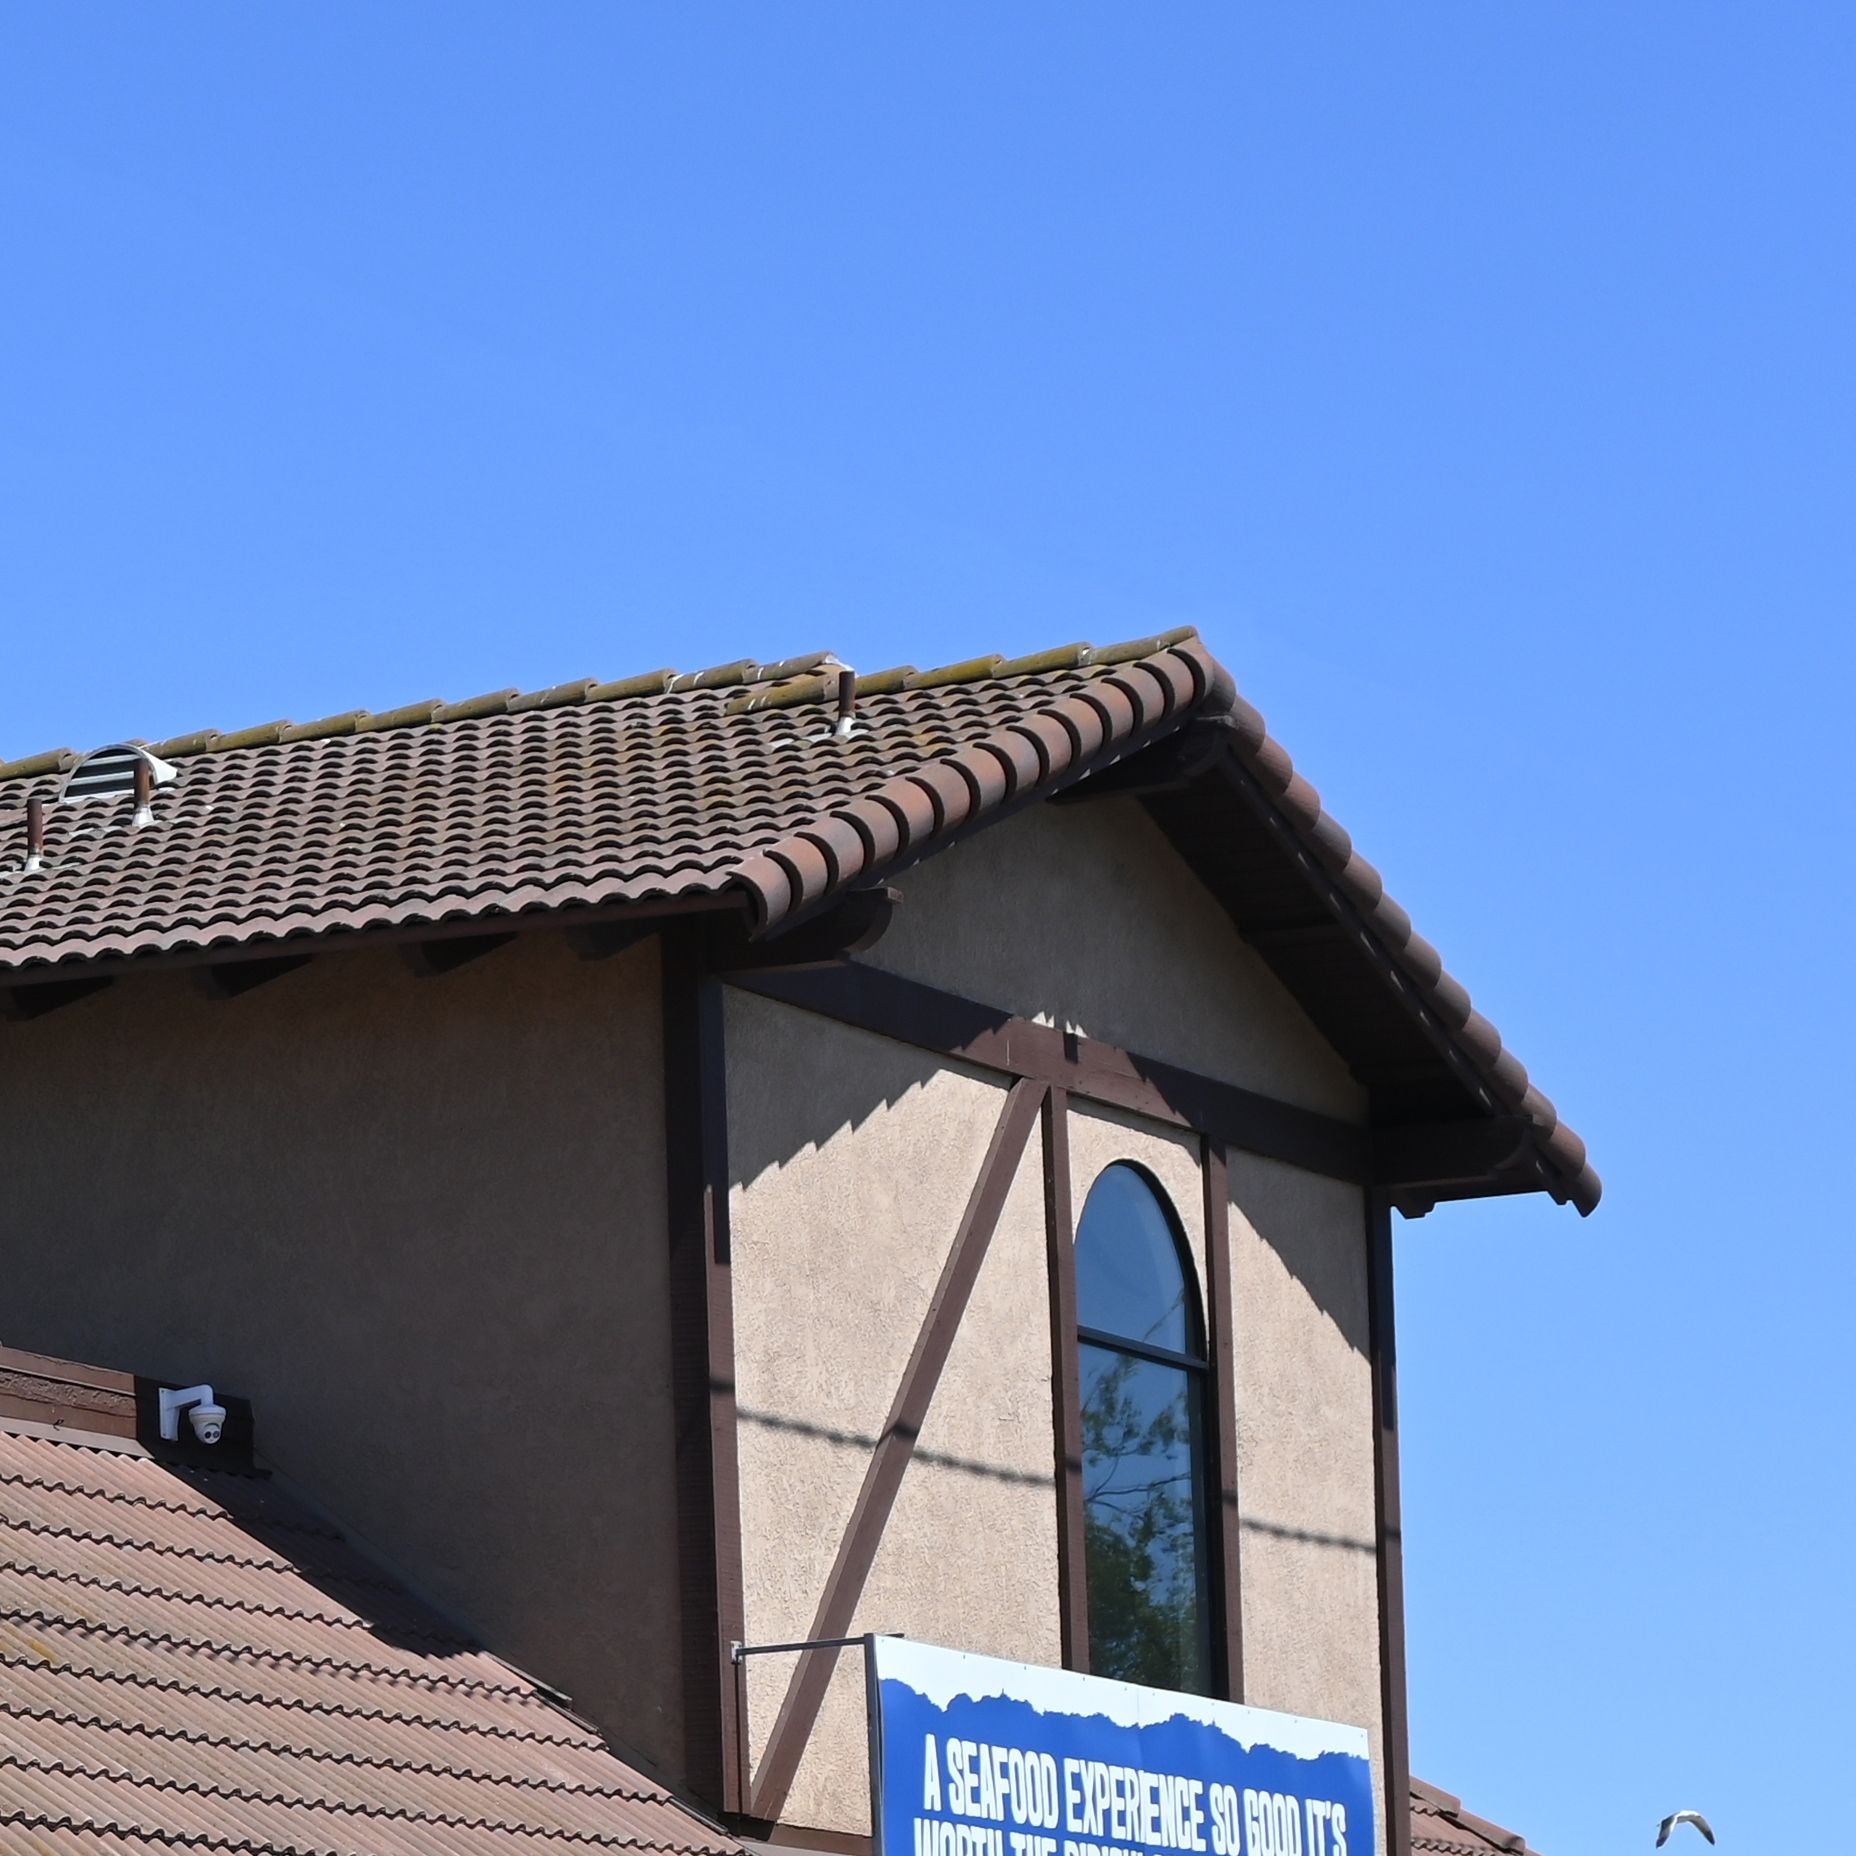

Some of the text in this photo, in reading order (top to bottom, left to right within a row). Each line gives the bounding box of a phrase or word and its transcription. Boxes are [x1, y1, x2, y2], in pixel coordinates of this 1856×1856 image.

[924, 1733, 941, 1811] A
[946, 1737, 1059, 1829] SEAFOOD
[1063, 1757, 1207, 1852] EXPERIENCE
